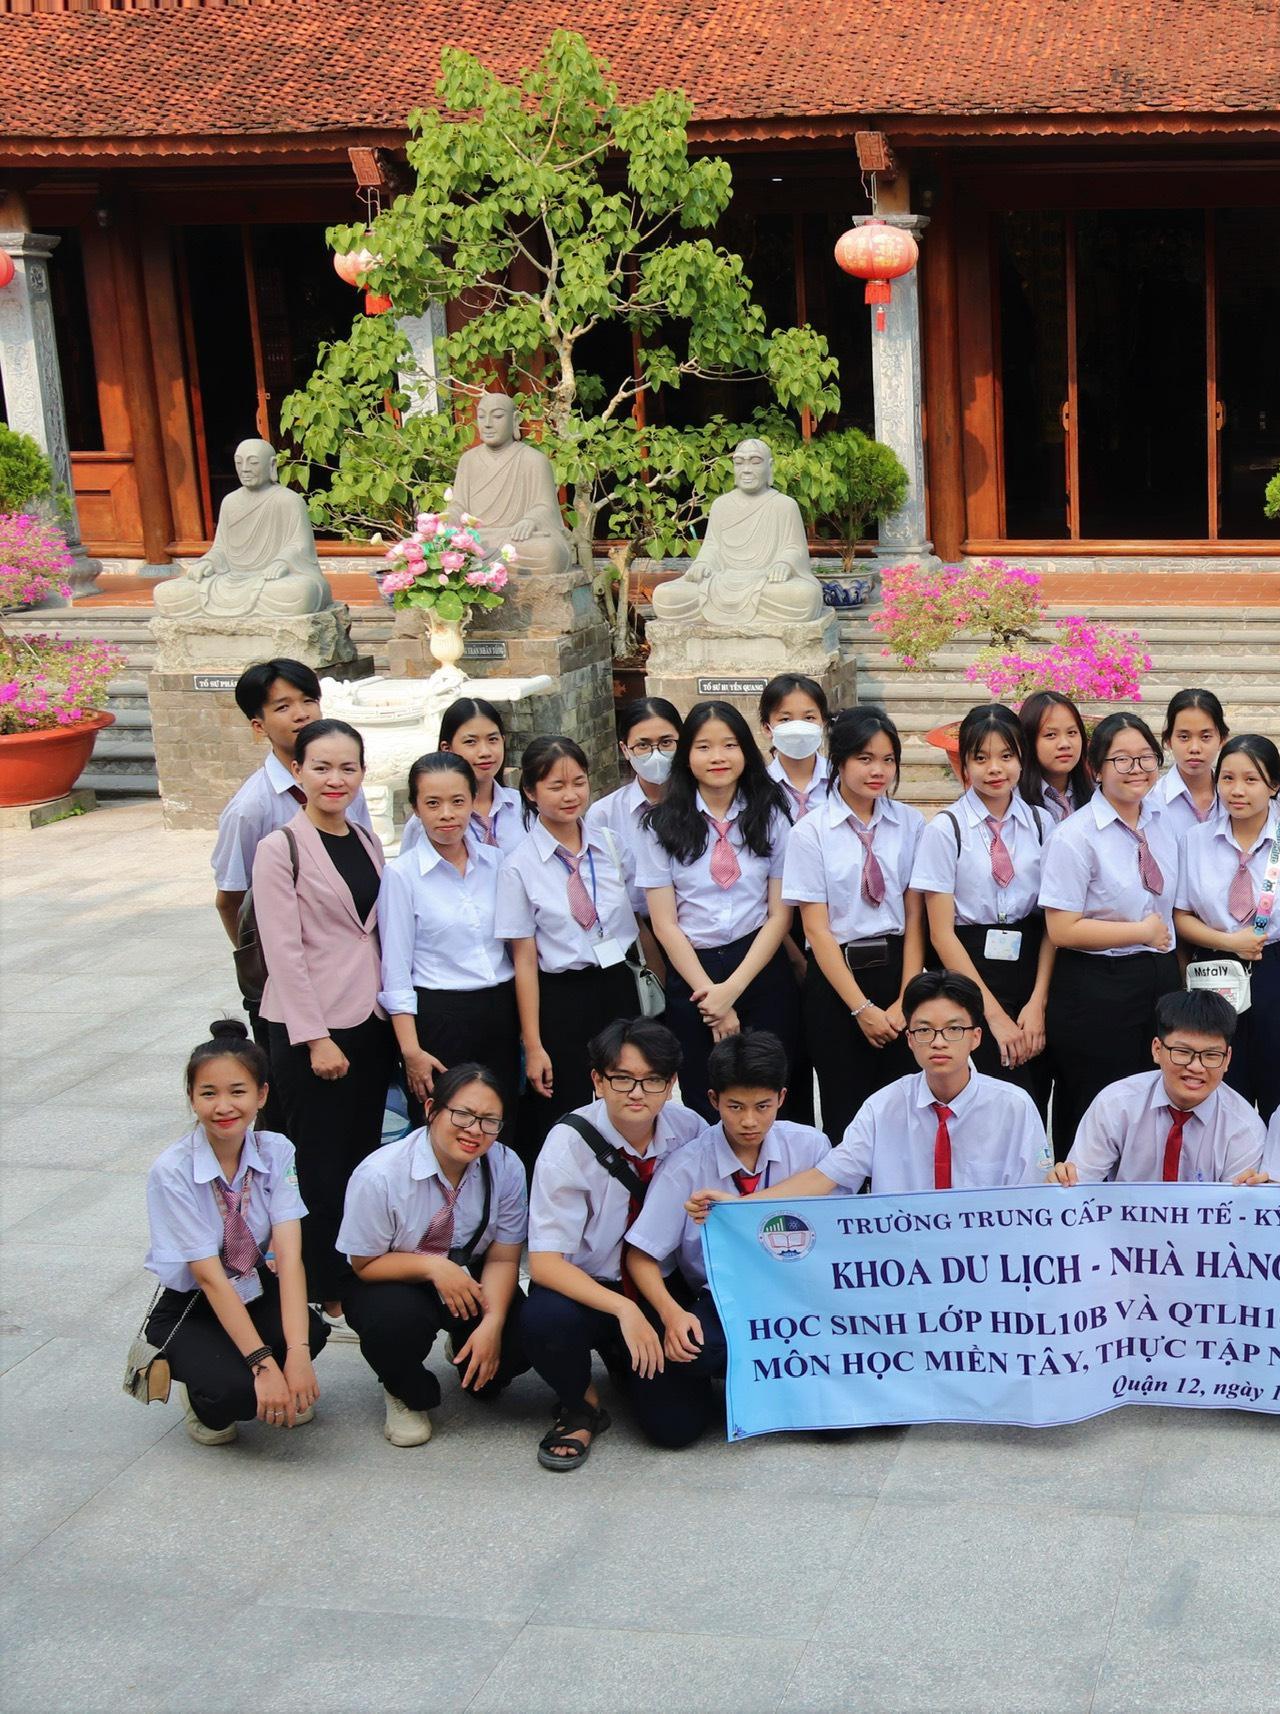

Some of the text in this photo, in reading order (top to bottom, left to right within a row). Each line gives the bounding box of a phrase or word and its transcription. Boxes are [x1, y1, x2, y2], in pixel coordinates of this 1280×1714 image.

[743, 684, 764, 692] QUANG
[837, 1210, 952, 1234] TRƯỜNG
[959, 1209, 1053, 1228] TRUNG
[1061, 1198, 1112, 1226] CẤP
[1120, 1206, 1189, 1224] KINH
[1197, 1201, 1233, 1224] TẾ
[832, 1259, 932, 1289] KHOA
[941, 1255, 988, 1283] DU
[1000, 1254, 1081, 1292] LỊCH
[1110, 1241, 1184, 1276] NHÀ
[748, 1315, 820, 1344] HỌC
[831, 1313, 907, 1335] SINH
[918, 1305, 982, 1333] LỚP
[990, 1306, 1107, 1335] HDL10B
[1115, 1294, 1158, 1321] VÀ
[752, 1349, 830, 1381] MÔN
[841, 1351, 914, 1380] HỌC
[925, 1345, 1008, 1373] MIỀN
[1017, 1347, 1089, 1375] TÂY,
[1096, 1336, 1186, 1364] THỰC
[1196, 1338, 1260, 1366] TẬP
[1113, 1375, 1167, 1398] Quận
[1177, 1378, 1205, 1397] 12,
[1214, 1381, 1264, 1401] ngày
